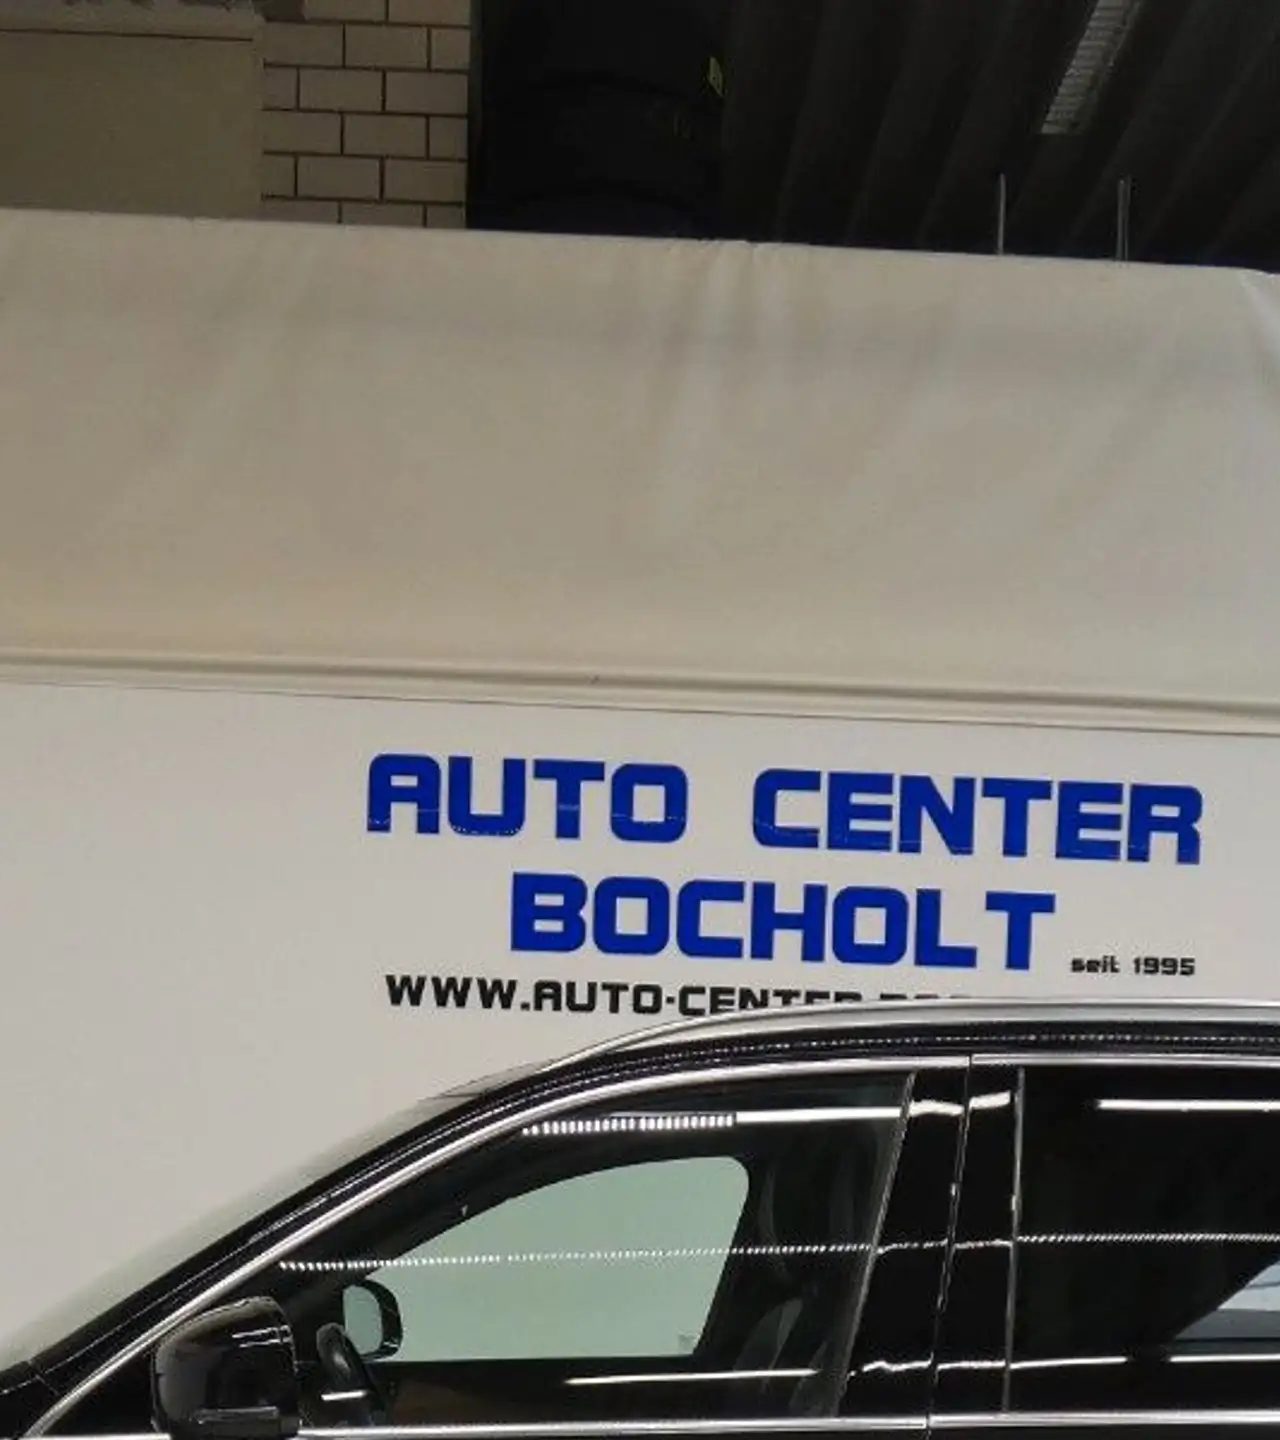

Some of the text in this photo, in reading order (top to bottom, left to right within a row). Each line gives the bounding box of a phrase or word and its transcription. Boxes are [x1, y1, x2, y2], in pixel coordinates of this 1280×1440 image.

[367, 753, 1204, 865] AUTO CENTER
[510, 871, 1057, 973] BOCHOLT
[1070, 955, 1196, 977] seit 1995
